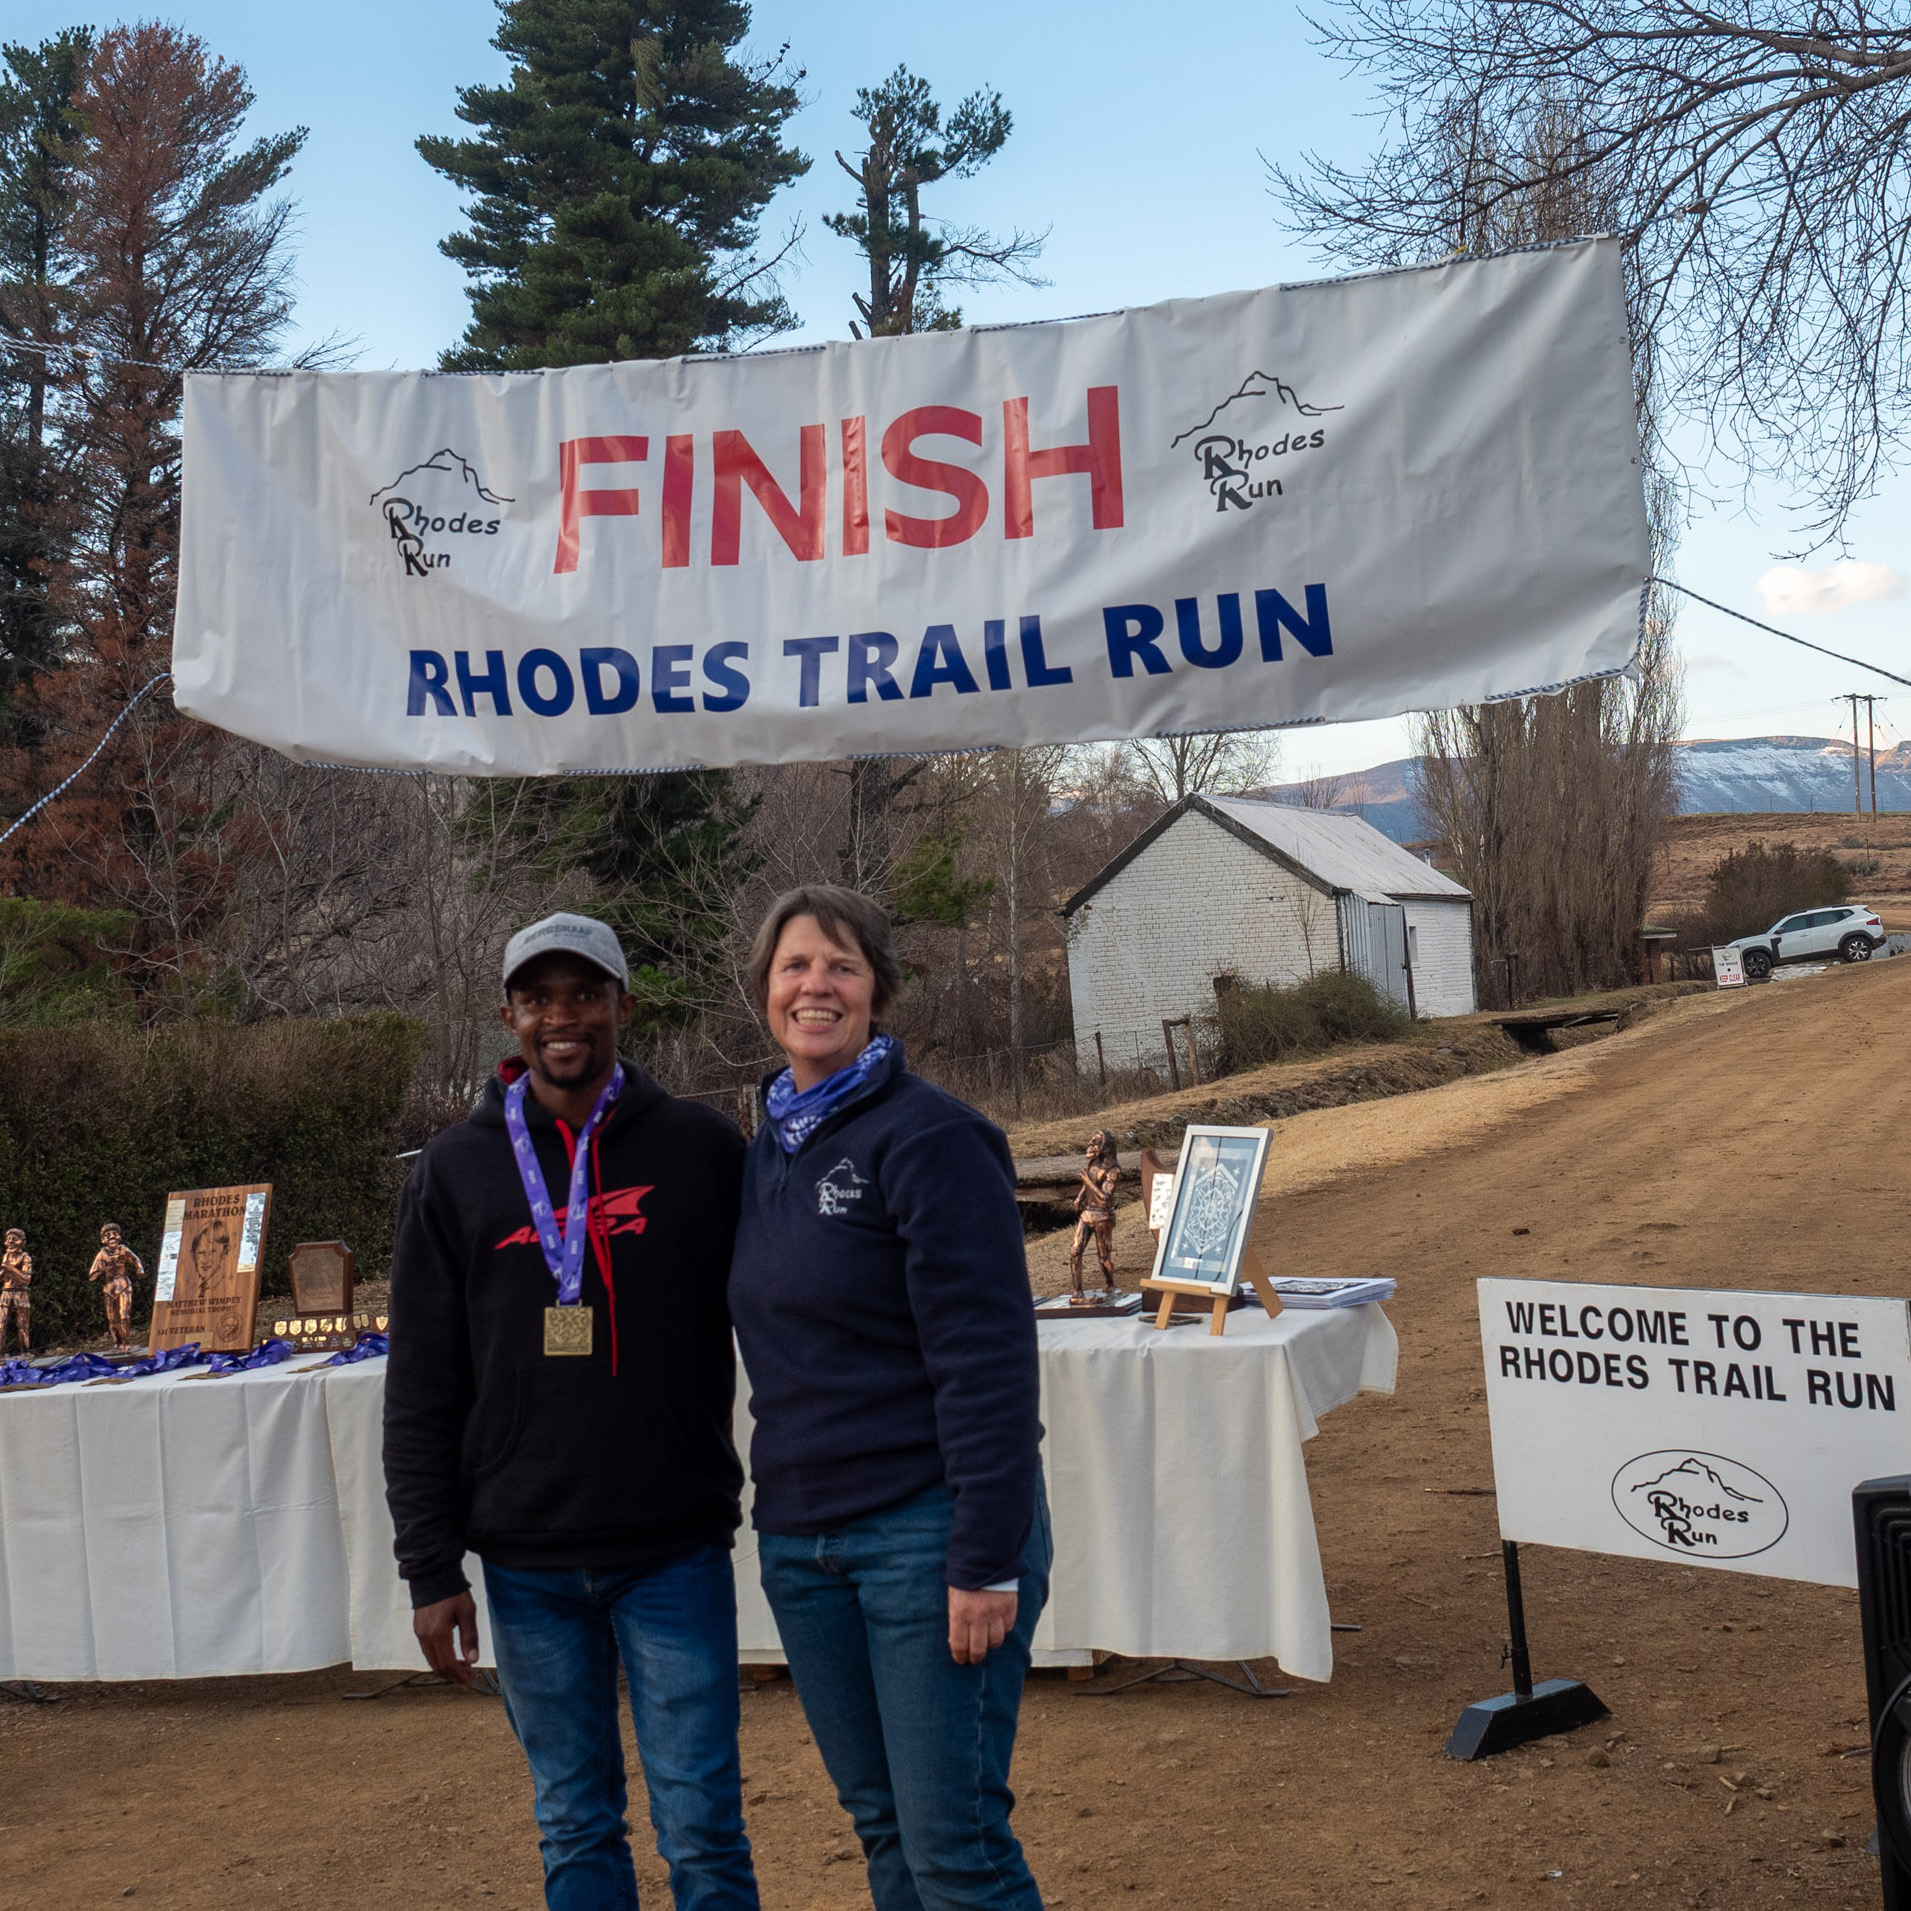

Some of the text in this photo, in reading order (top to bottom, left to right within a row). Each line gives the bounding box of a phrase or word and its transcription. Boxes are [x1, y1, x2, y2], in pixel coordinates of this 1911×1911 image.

[1194, 429, 1324, 480] Rhodes
[554, 386, 1124, 574] FINISH
[1210, 469, 1283, 512] Run
[383, 498, 500, 539] Rhodes
[398, 534, 450, 577] Run
[406, 583, 1335, 717] RHODES TRAIL RUN
[183, 1206, 246, 1220] MARATHON
[193, 1194, 241, 1208] RHODES
[819, 1197, 848, 1215] Run
[167, 1299, 207, 1309] MATTHEW
[170, 1325, 206, 1335] VETERAN
[1506, 1301, 1862, 1358] WELCOME TO THE
[1500, 1345, 1896, 1412] RHODES TRAIL RUN
[1647, 1491, 1750, 1523] Rhodes
[1661, 1516, 1718, 1547] Run
